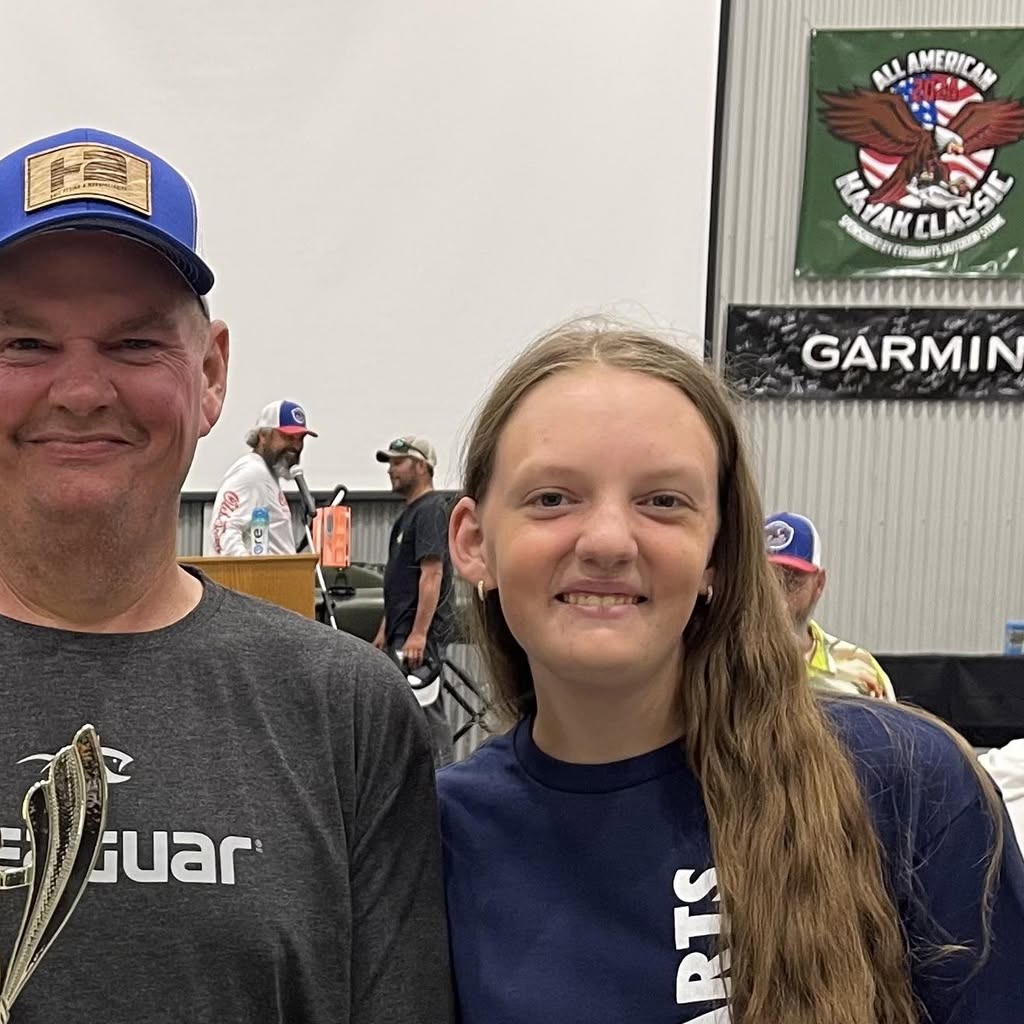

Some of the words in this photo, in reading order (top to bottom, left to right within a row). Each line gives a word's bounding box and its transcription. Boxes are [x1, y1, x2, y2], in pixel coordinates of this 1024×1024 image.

[873, 58, 906, 91] ALL
[907, 49, 998, 92] AMERICAN
[835, 170, 910, 239] KAYAK
[914, 169, 1015, 240] CLASSIC
[801, 334, 1024, 372] GARMIN
[253, 528, 264, 555] ore
